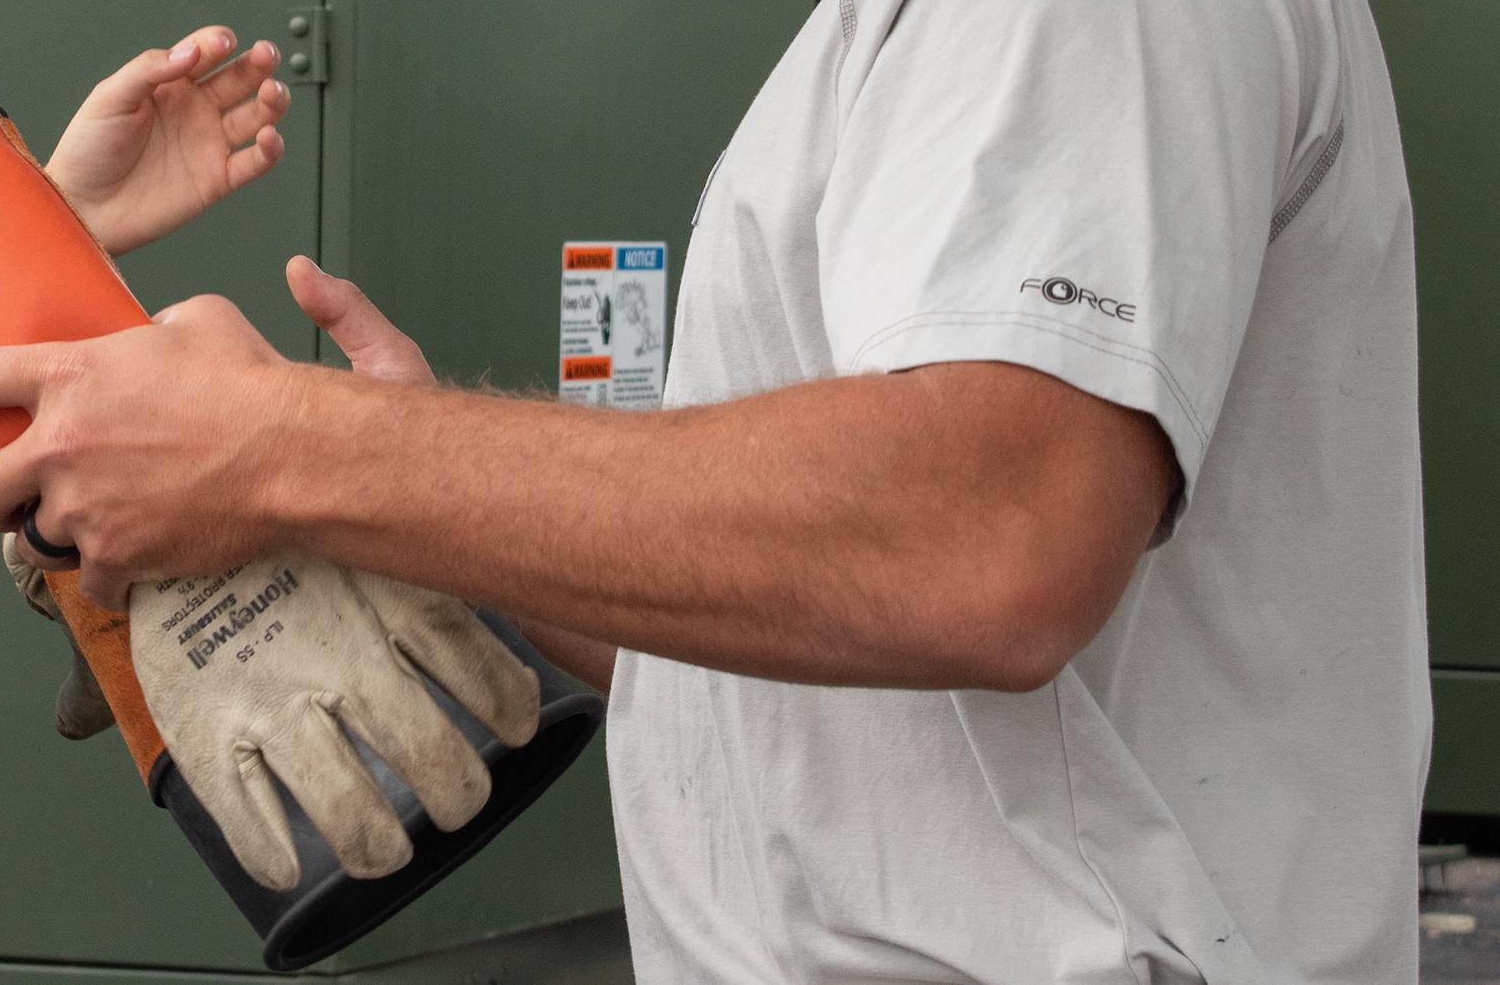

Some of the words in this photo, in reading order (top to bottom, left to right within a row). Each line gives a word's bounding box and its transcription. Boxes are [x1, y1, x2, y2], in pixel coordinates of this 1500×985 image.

[576, 252, 610, 269] WARNING
[624, 250, 657, 268] NOTICE
[562, 295, 578, 312] Keep
[1020, 277, 1137, 323] FORCE
[573, 362, 608, 378] WARNING
[161, 575, 227, 632] PROTECTORS
[178, 593, 237, 645] SALISBURY
[186, 568, 299, 670] Honeywell
[264, 620, 284, 643] ILP
[236, 644, 255, 663] 5S
